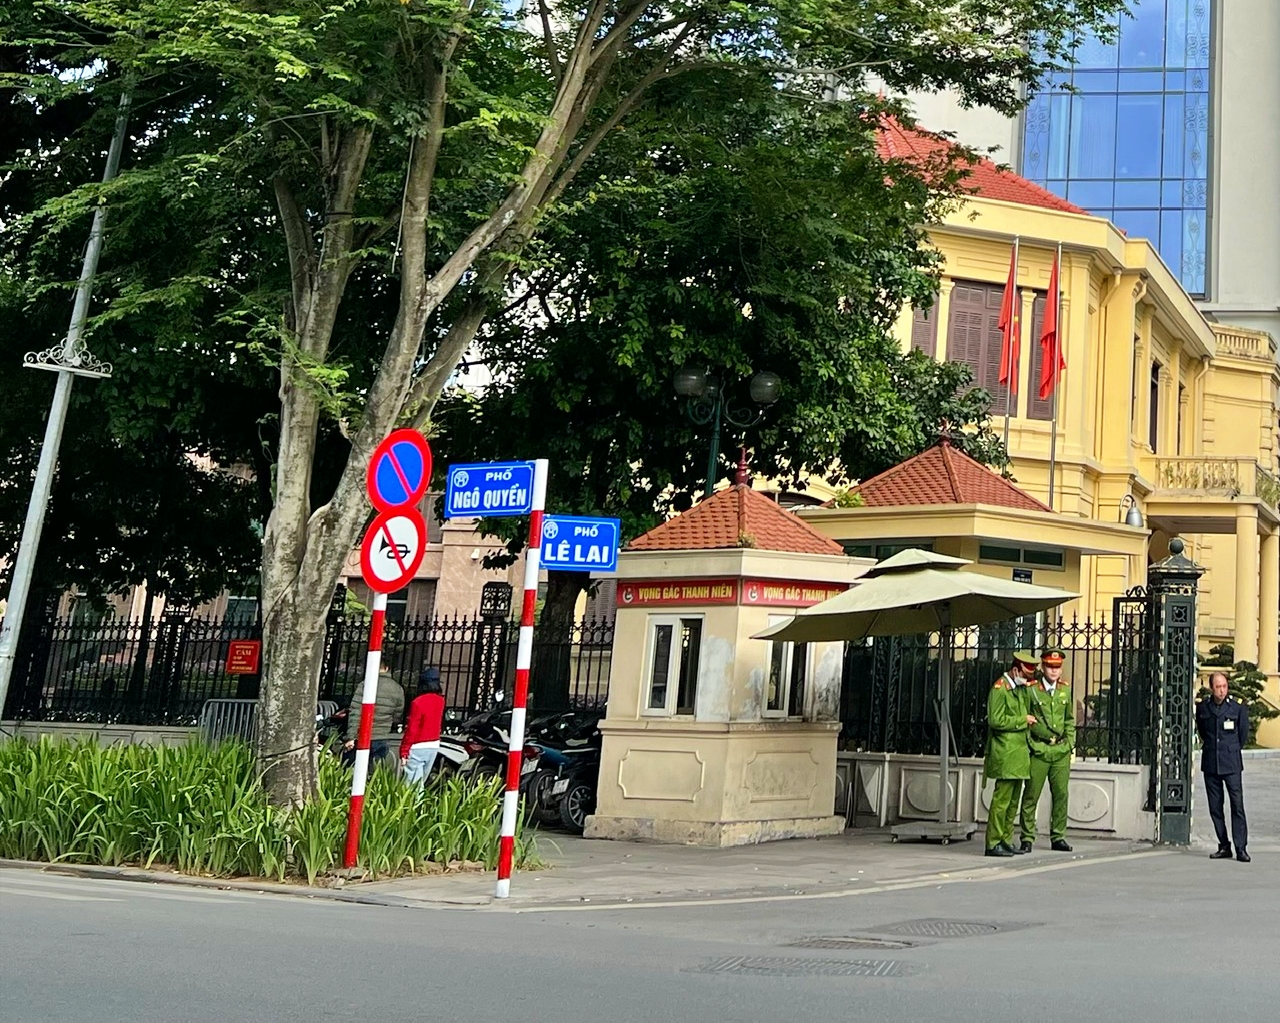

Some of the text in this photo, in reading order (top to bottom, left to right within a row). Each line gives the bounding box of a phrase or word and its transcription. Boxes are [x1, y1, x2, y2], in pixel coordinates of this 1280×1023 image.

[485, 467, 513, 481] PHỐ
[453, 486, 480, 508] NGÔ
[574, 523, 600, 537] PHỐ
[544, 540, 609, 563] LÊ LAI
[639, 584, 732, 602] VỌNG GÁC THANH NIÊN
[763, 587, 783, 602] VỌNG
[785, 586, 800, 601] GÁC
[801, 588, 826, 602] THANH
